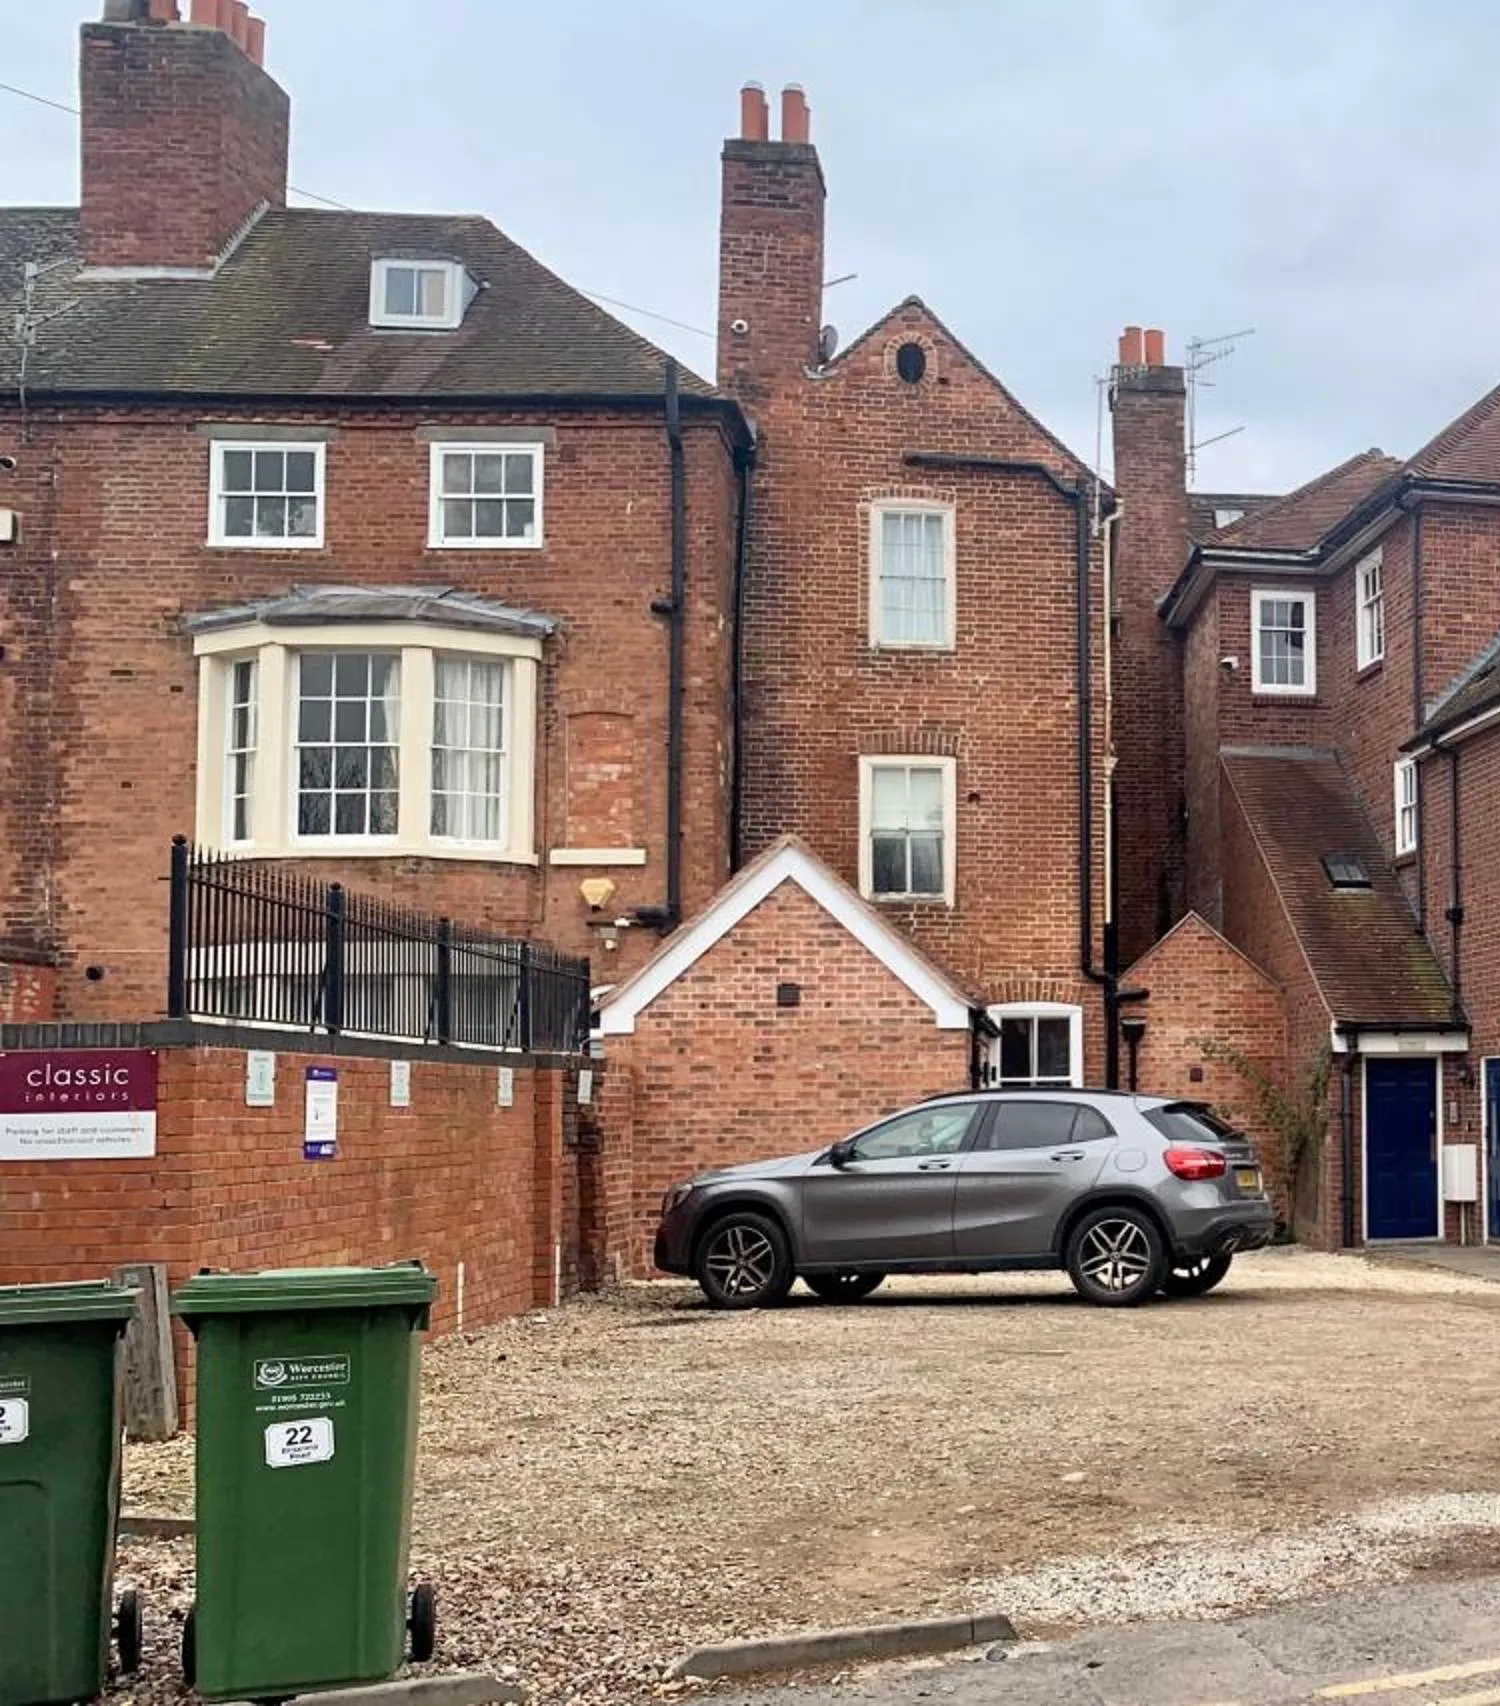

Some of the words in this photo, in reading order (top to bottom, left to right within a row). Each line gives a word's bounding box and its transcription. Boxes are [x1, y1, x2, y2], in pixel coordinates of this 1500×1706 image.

[27, 1063, 129, 1087] classic
[24, 1091, 129, 1103] interiors
[289, 1362, 346, 1373] Worcester
[285, 1425, 313, 1447] 22
